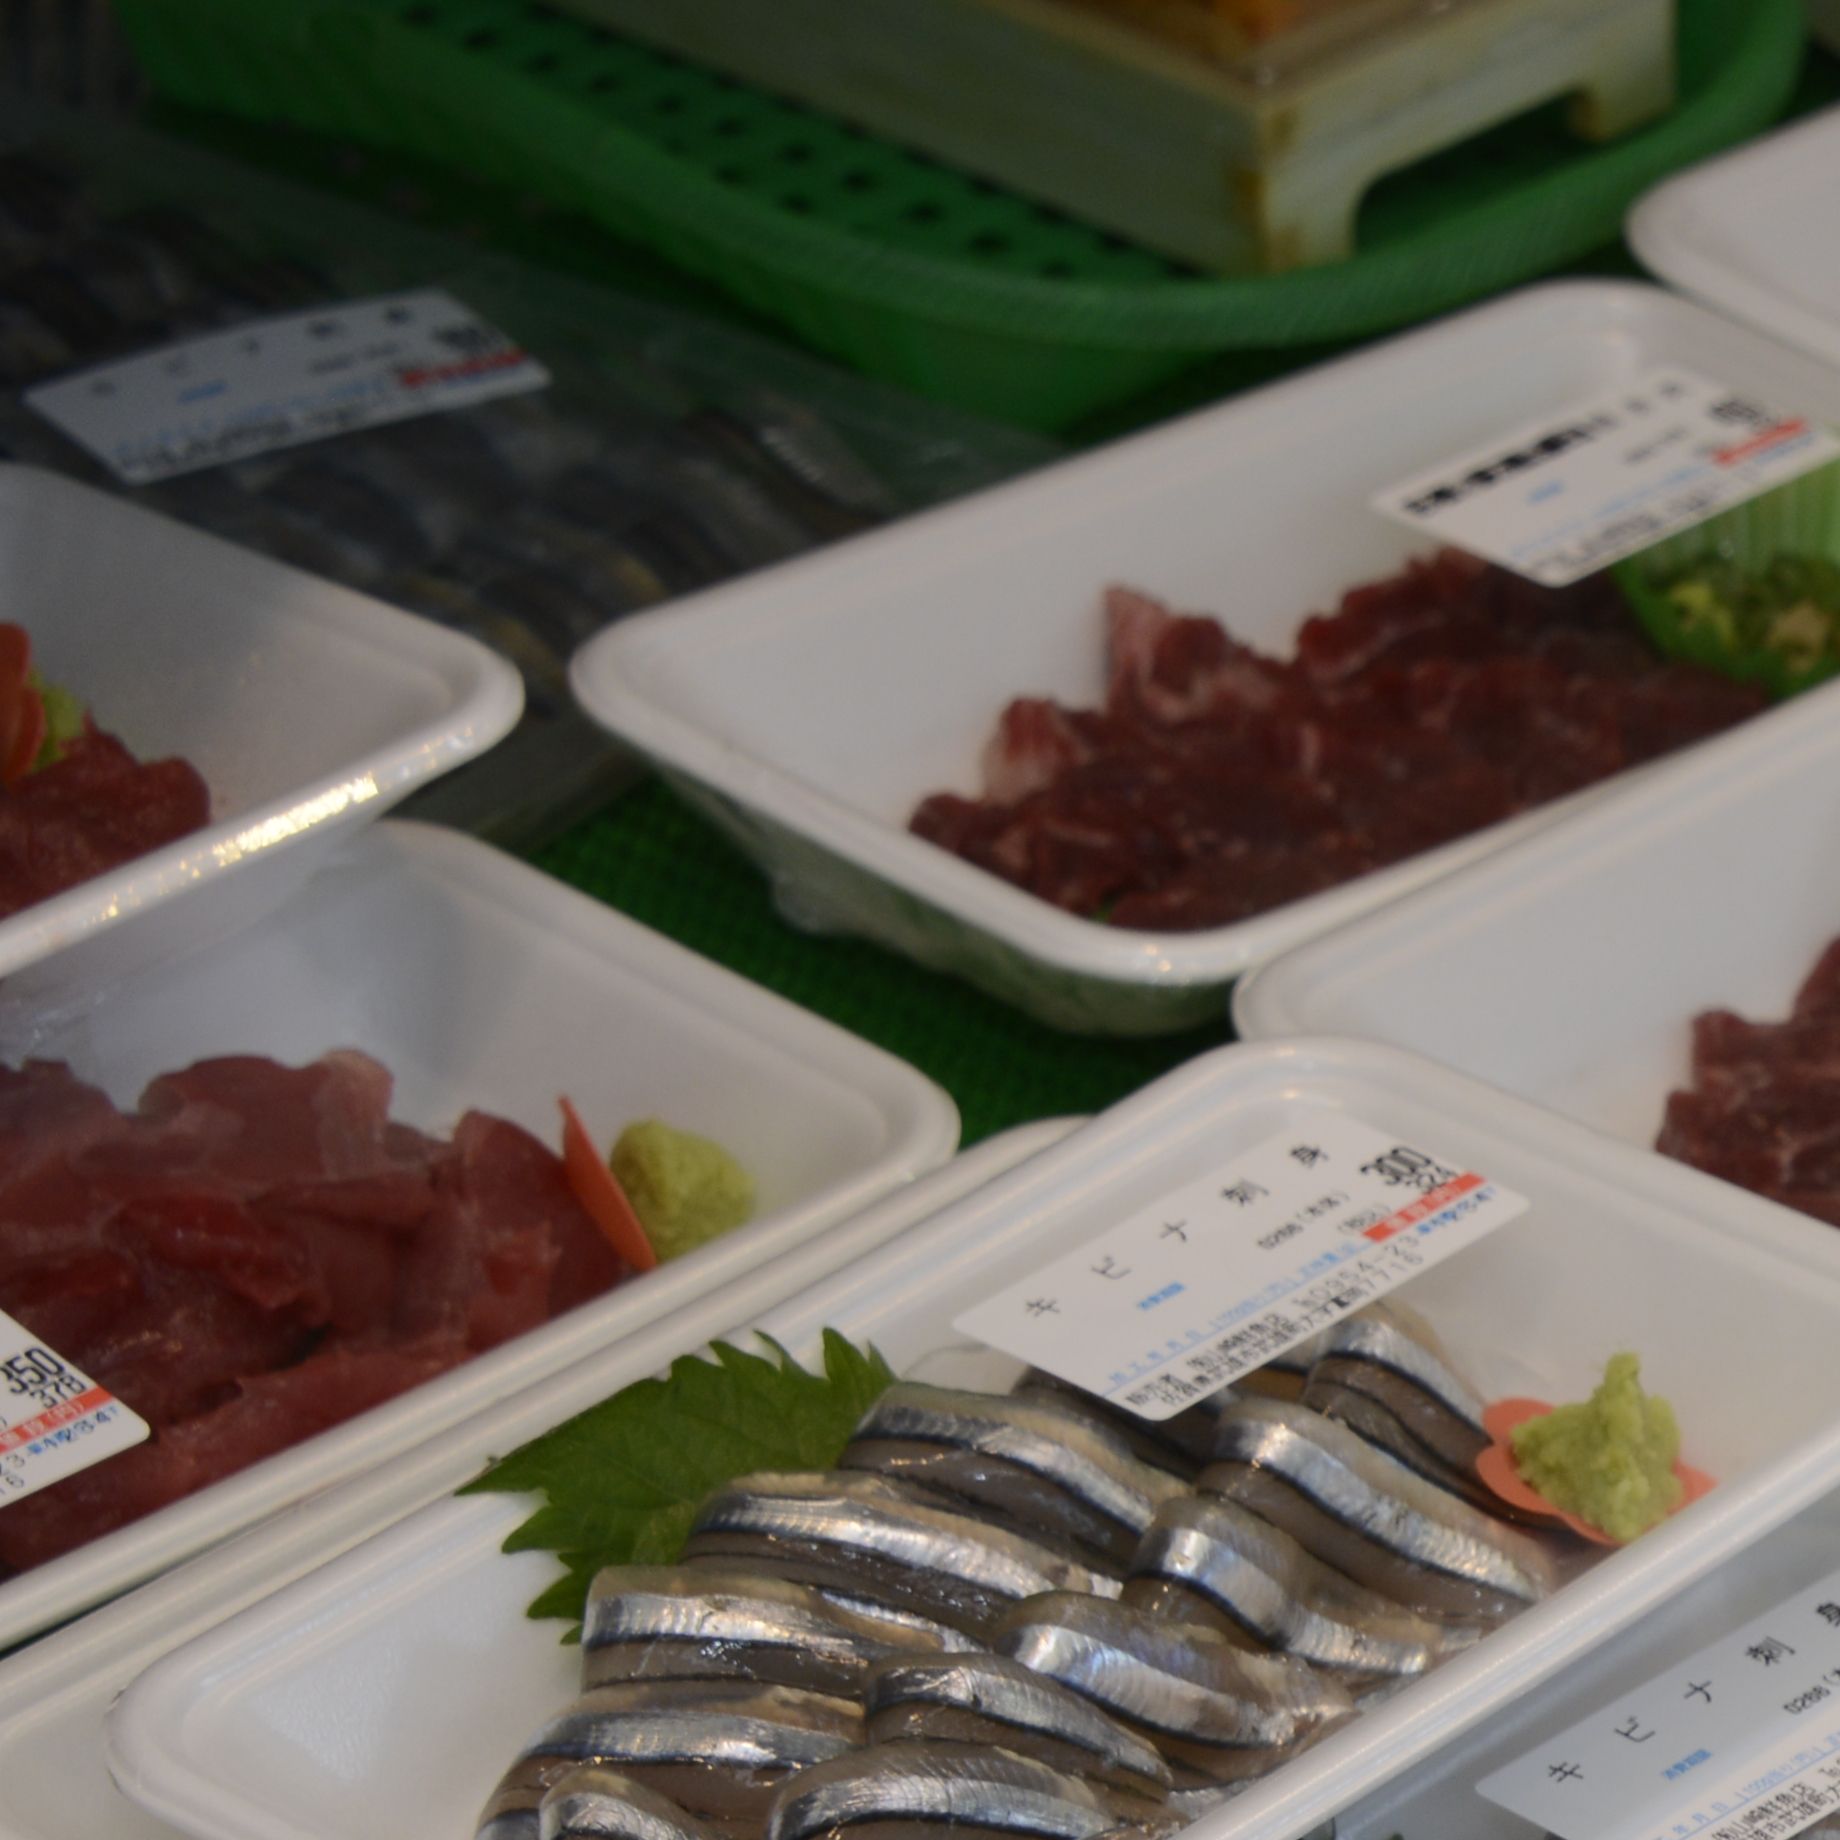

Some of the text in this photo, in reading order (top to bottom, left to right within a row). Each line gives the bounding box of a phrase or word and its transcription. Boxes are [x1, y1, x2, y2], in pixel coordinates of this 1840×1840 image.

[1359, 1147, 1434, 1185] 300
[1404, 1164, 1458, 1194] 324
[1022, 1142, 1332, 1321] キビナ刺身
